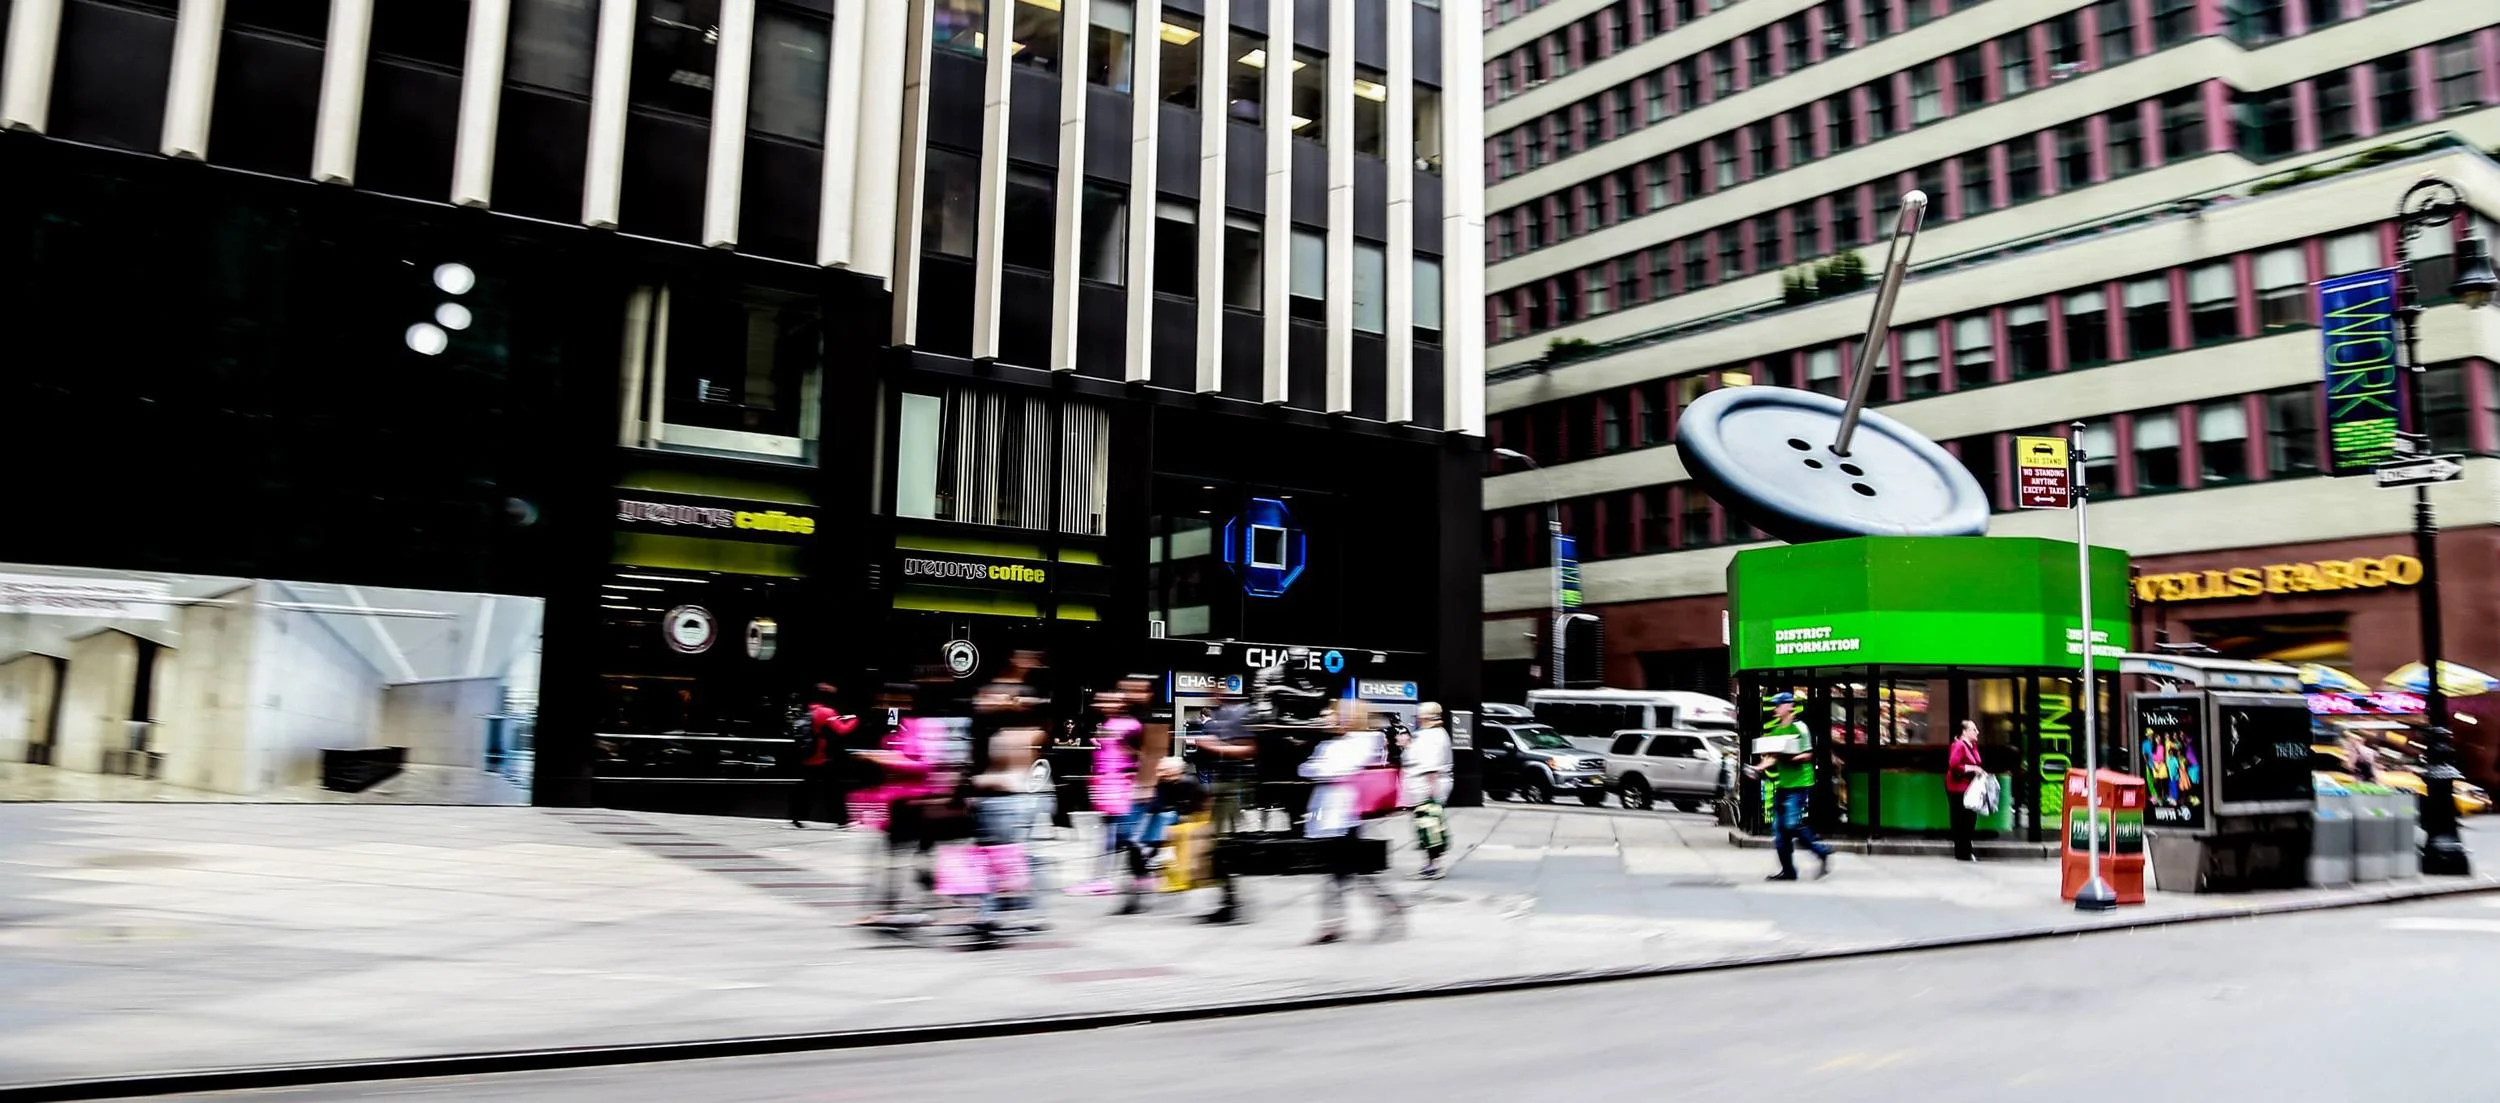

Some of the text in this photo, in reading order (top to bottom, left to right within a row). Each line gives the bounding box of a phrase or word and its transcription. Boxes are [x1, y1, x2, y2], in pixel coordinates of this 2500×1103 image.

[2325, 296, 2399, 418] WORK
[2023, 468, 2065, 477] NO STANDING
[2031, 478, 2058, 486] ANYTIME
[2023, 486, 2066, 495] EXCEPT TAXIS
[904, 557, 1045, 583] gregorys coffee
[2259, 553, 2424, 595] FARGO
[1775, 626, 1832, 642] DISTRICT
[1775, 638, 1860, 655] INFORMATION
[1178, 675, 1227, 690] CHASE
[1361, 683, 1404, 697] CHASE
[887, 709, 896, 721] A
[2039, 693, 2072, 781] INFO
